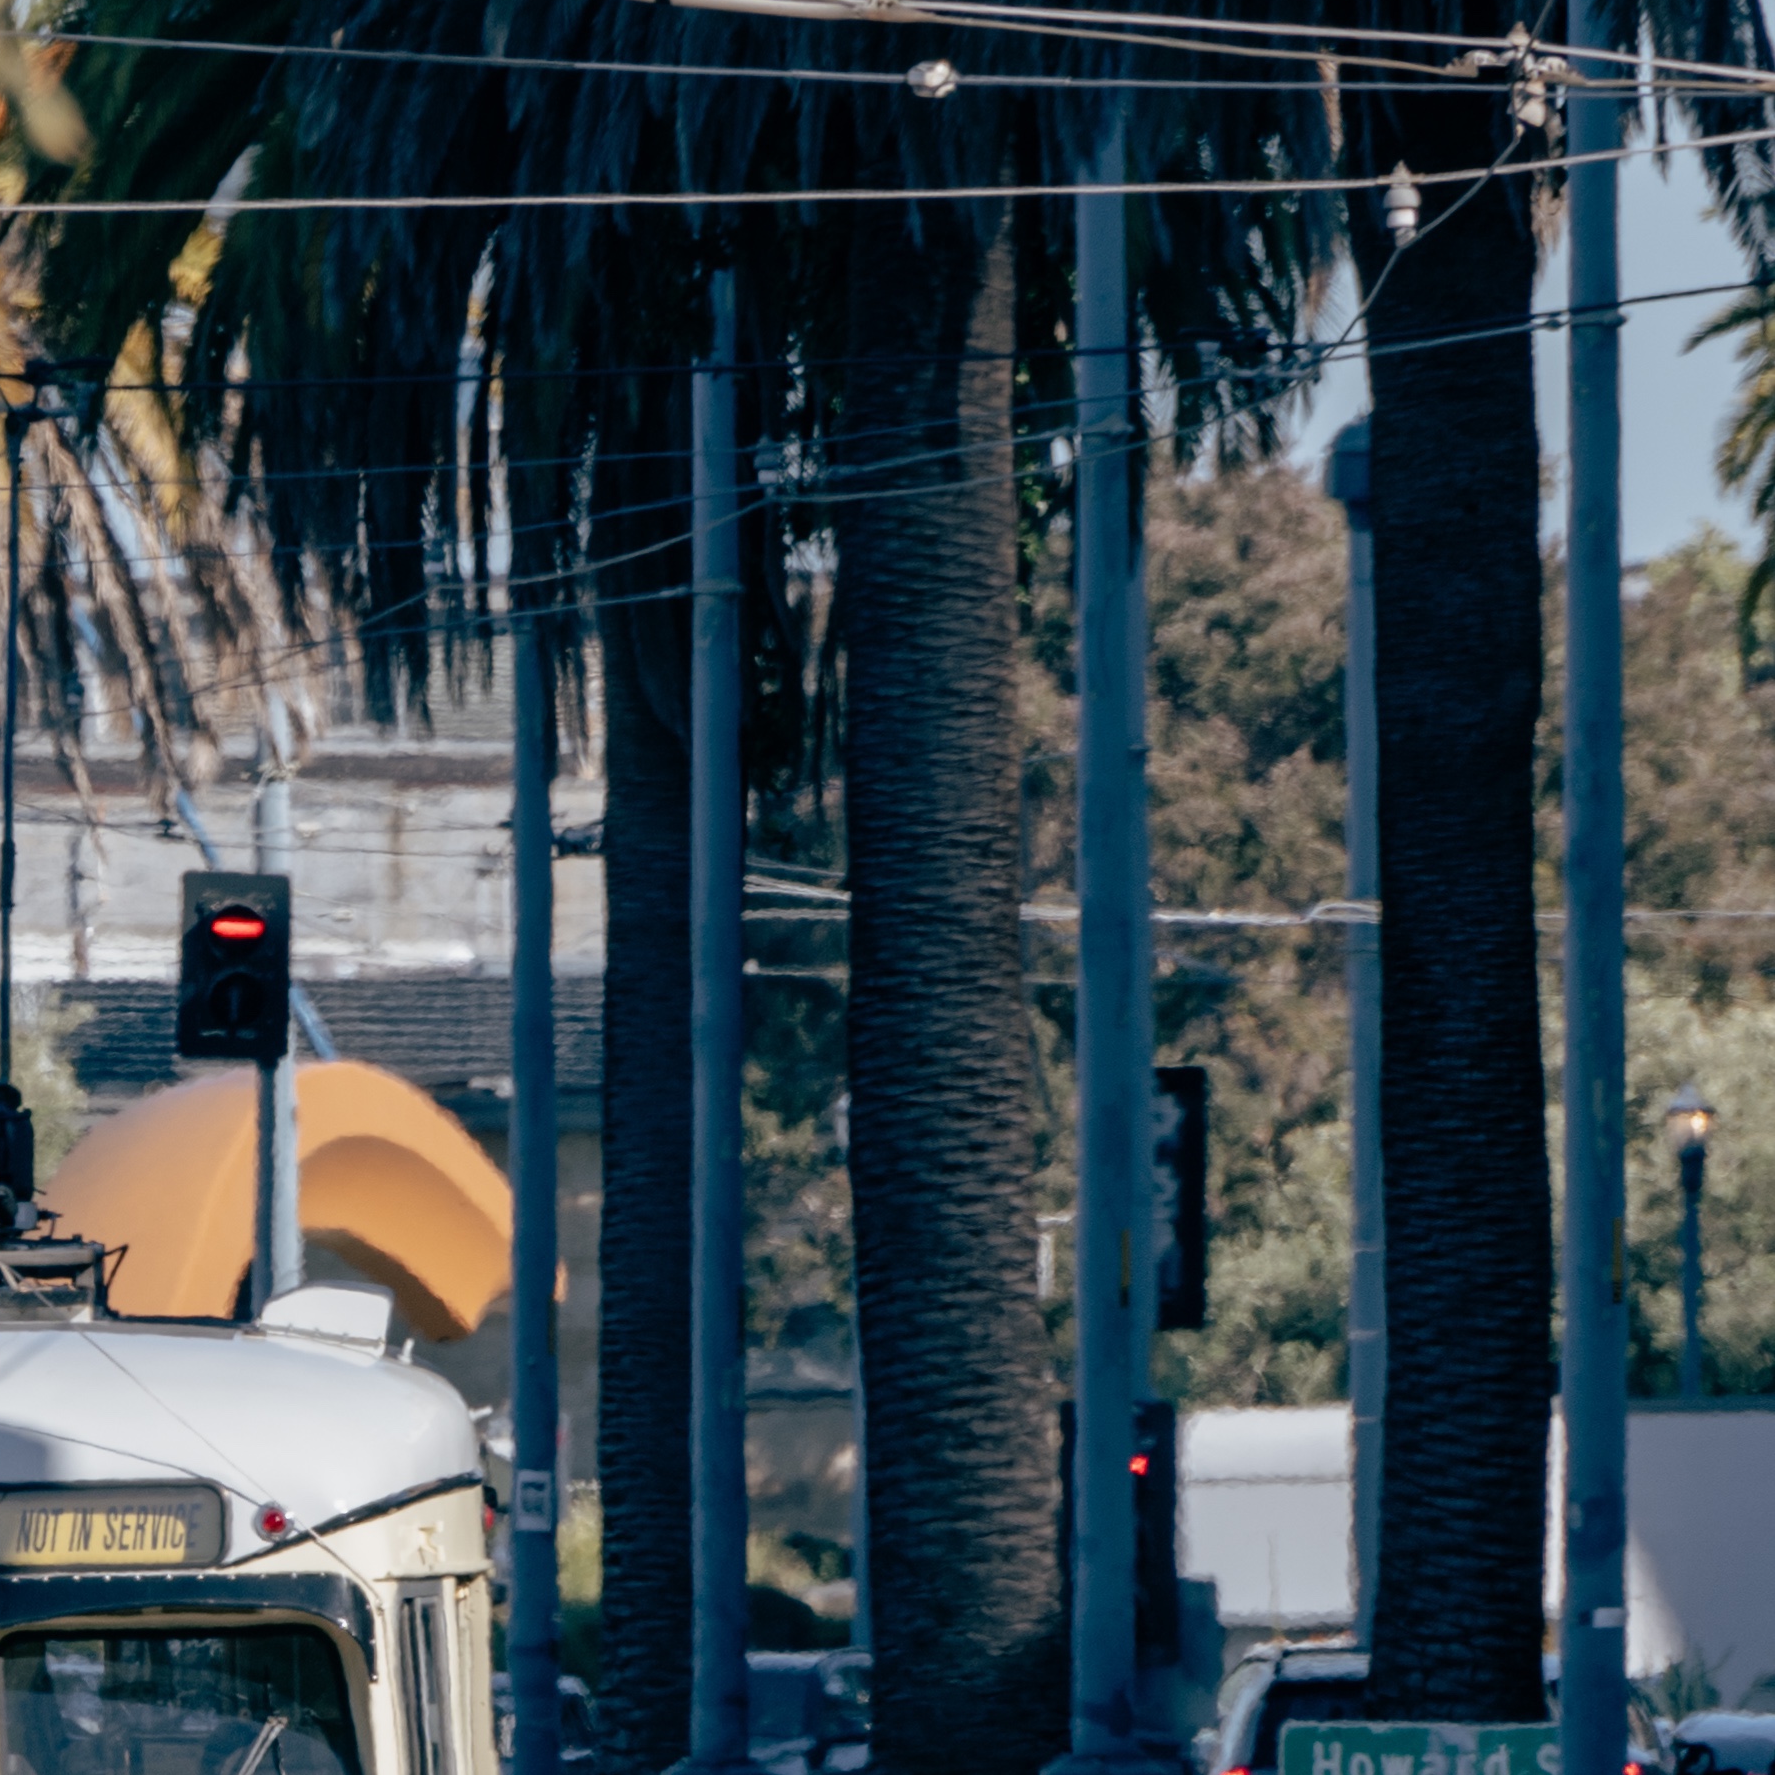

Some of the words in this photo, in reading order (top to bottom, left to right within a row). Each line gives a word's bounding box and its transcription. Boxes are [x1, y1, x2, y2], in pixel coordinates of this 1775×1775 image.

[16, 1507, 63, 1554] NOT
[68, 1506, 94, 1553] IN
[103, 1501, 203, 1551] SERVICE
